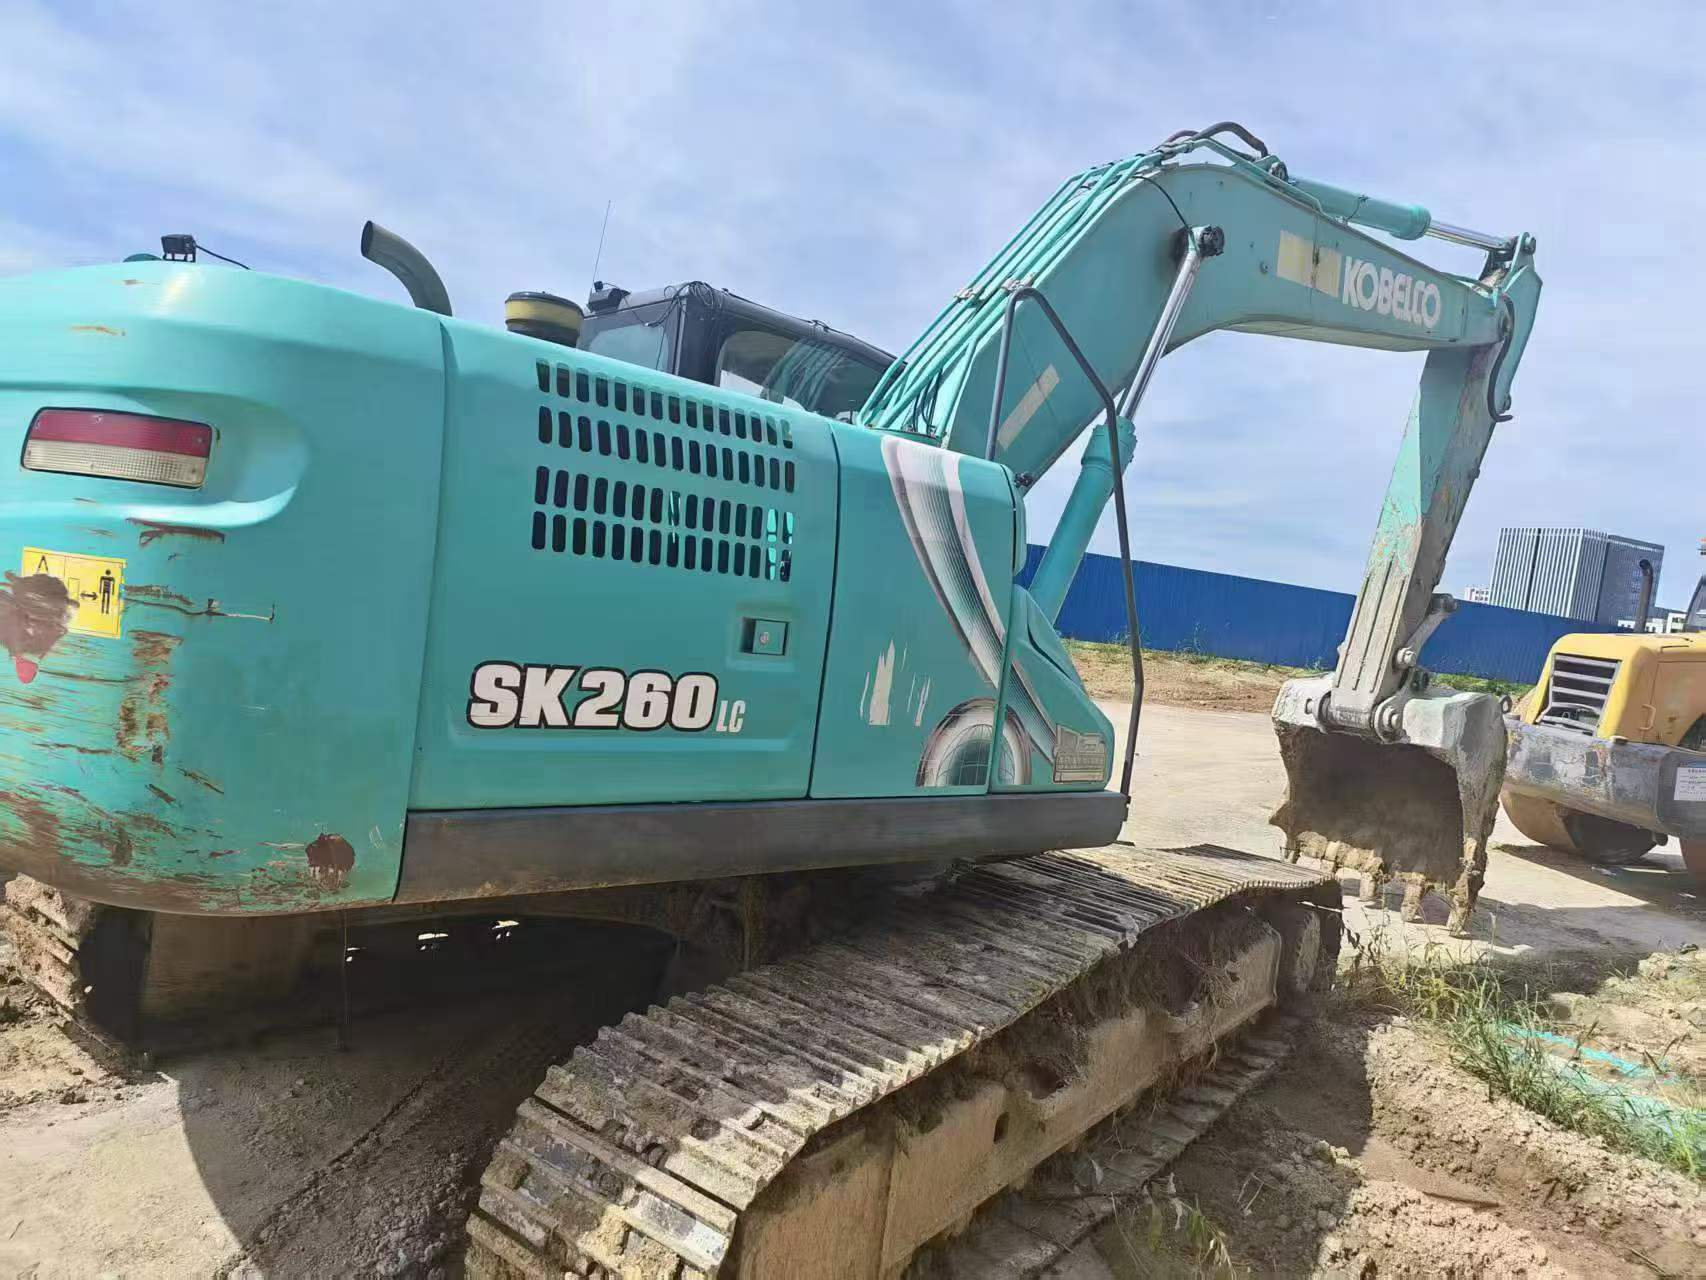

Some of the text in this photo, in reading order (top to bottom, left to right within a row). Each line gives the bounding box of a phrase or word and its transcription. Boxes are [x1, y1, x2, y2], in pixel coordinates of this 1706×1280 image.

[1343, 256, 1441, 328] KOBELCO
[467, 660, 746, 733] SK260 LC
